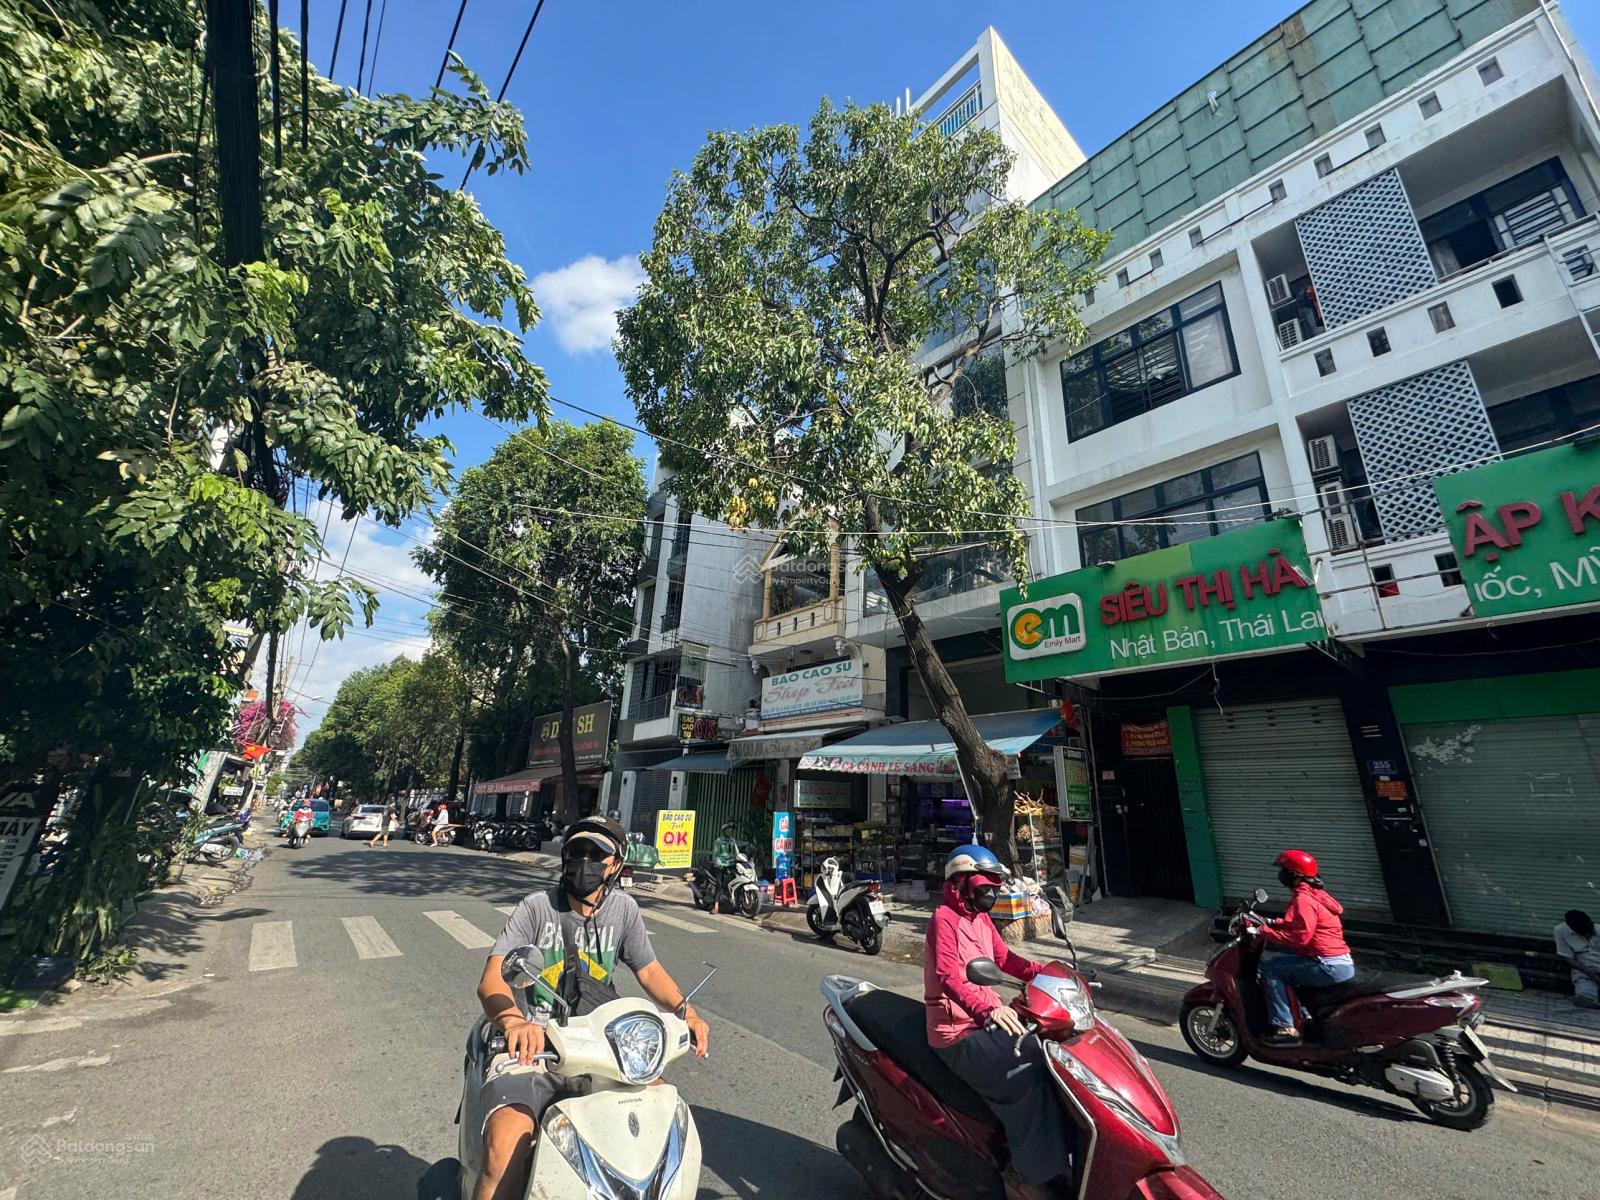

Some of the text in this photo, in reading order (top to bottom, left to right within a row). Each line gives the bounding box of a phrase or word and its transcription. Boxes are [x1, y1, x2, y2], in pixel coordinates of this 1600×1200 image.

[1456, 499, 1542, 562] ẬP
[1101, 581, 1169, 625] SIÊU
[1175, 566, 1237, 610] THỊ
[1044, 635, 1081, 649] Emily Mart
[1110, 634, 1156, 659] Nhật
[1164, 625, 1216, 651] Bản,
[1219, 608, 1274, 642] Thái
[771, 661, 852, 687] BAO CAO SU
[576, 714, 595, 735] SH
[695, 718, 716, 740] OK
[903, 761, 935, 773] SANG
[663, 831, 688, 846] OK
[618, 1097, 643, 1105] HONDA
